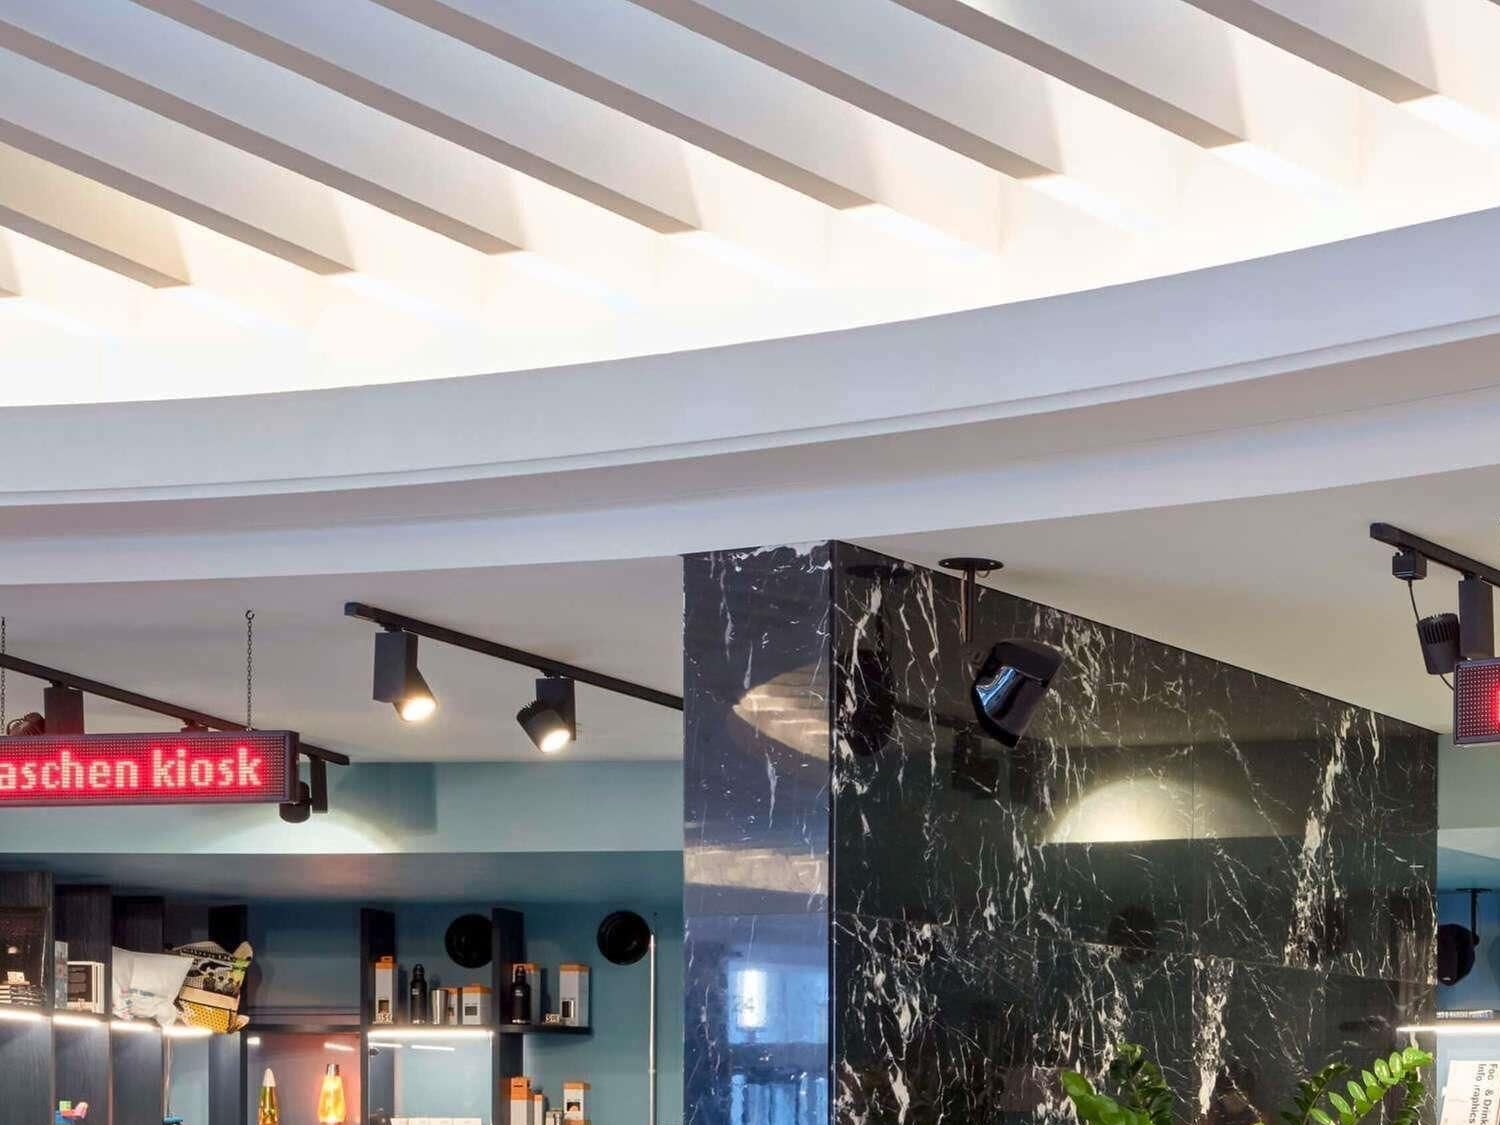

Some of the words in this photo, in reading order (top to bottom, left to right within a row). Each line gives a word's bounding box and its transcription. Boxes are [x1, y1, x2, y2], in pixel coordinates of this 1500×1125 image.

[151, 747, 262, 788] kiosk
[1487, 1063, 1498, 1084] Foo
[1468, 1063, 1486, 1125] Inforaphics
[1479, 1099, 1492, 1125] Drink
